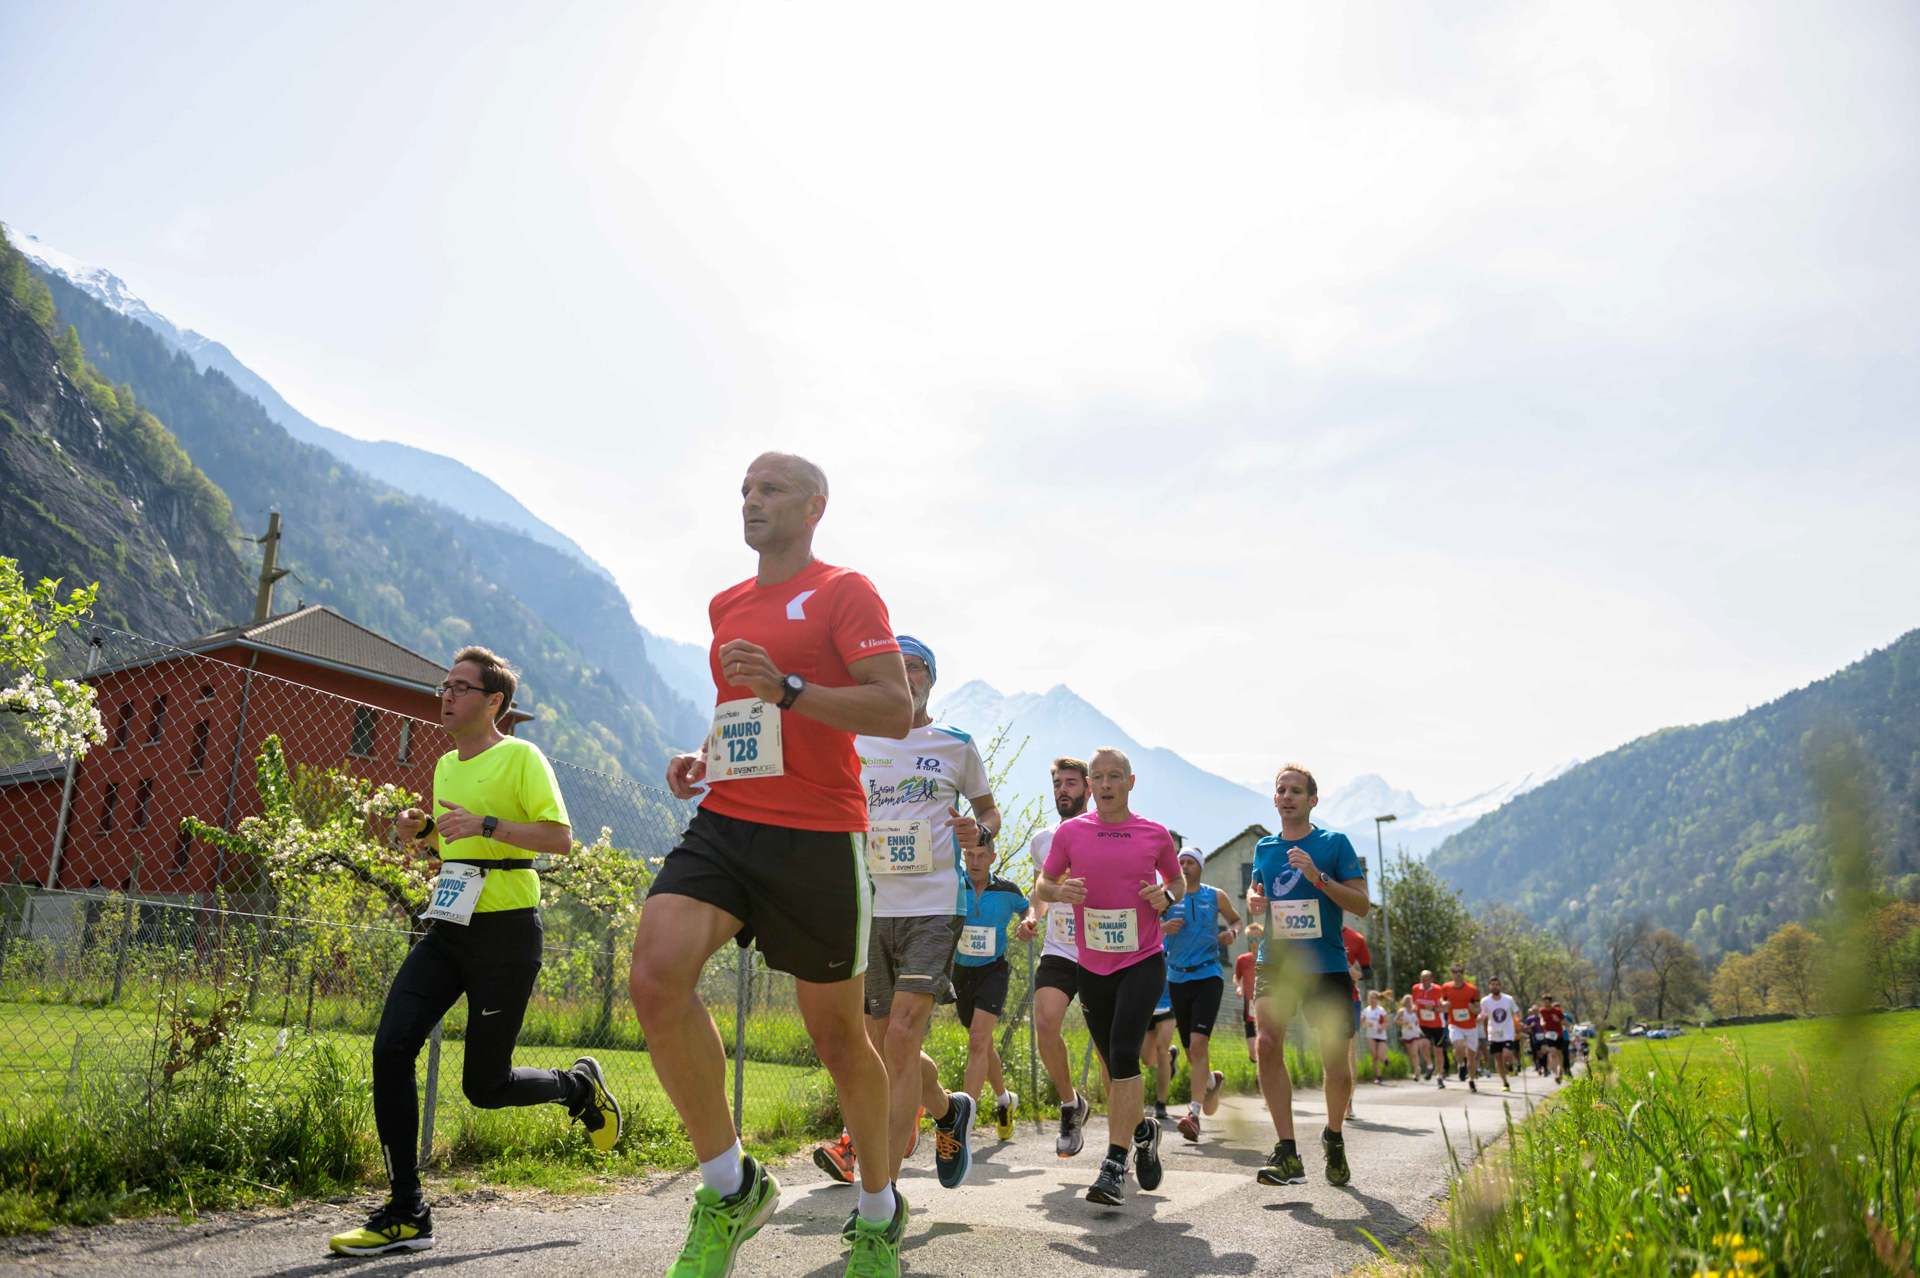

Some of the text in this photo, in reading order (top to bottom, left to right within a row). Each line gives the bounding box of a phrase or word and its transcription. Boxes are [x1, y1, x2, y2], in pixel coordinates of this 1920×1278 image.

[750, 705, 763, 714] aet
[722, 721, 761, 739] MAURO
[727, 737, 758, 762] 128
[916, 757, 940, 768] 10
[733, 764, 776, 775] EVENTMORE
[874, 786, 895, 794] LAGHI
[887, 835, 916, 846] ENNIO
[890, 846, 915, 862] 563
[437, 878, 467, 892] DAVIDE
[434, 890, 459, 907] 127
[1098, 921, 1127, 930] DAMIANO
[1285, 914, 1316, 929] 9292
[1104, 930, 1125, 943] 116
[971, 941, 986, 950] 484
